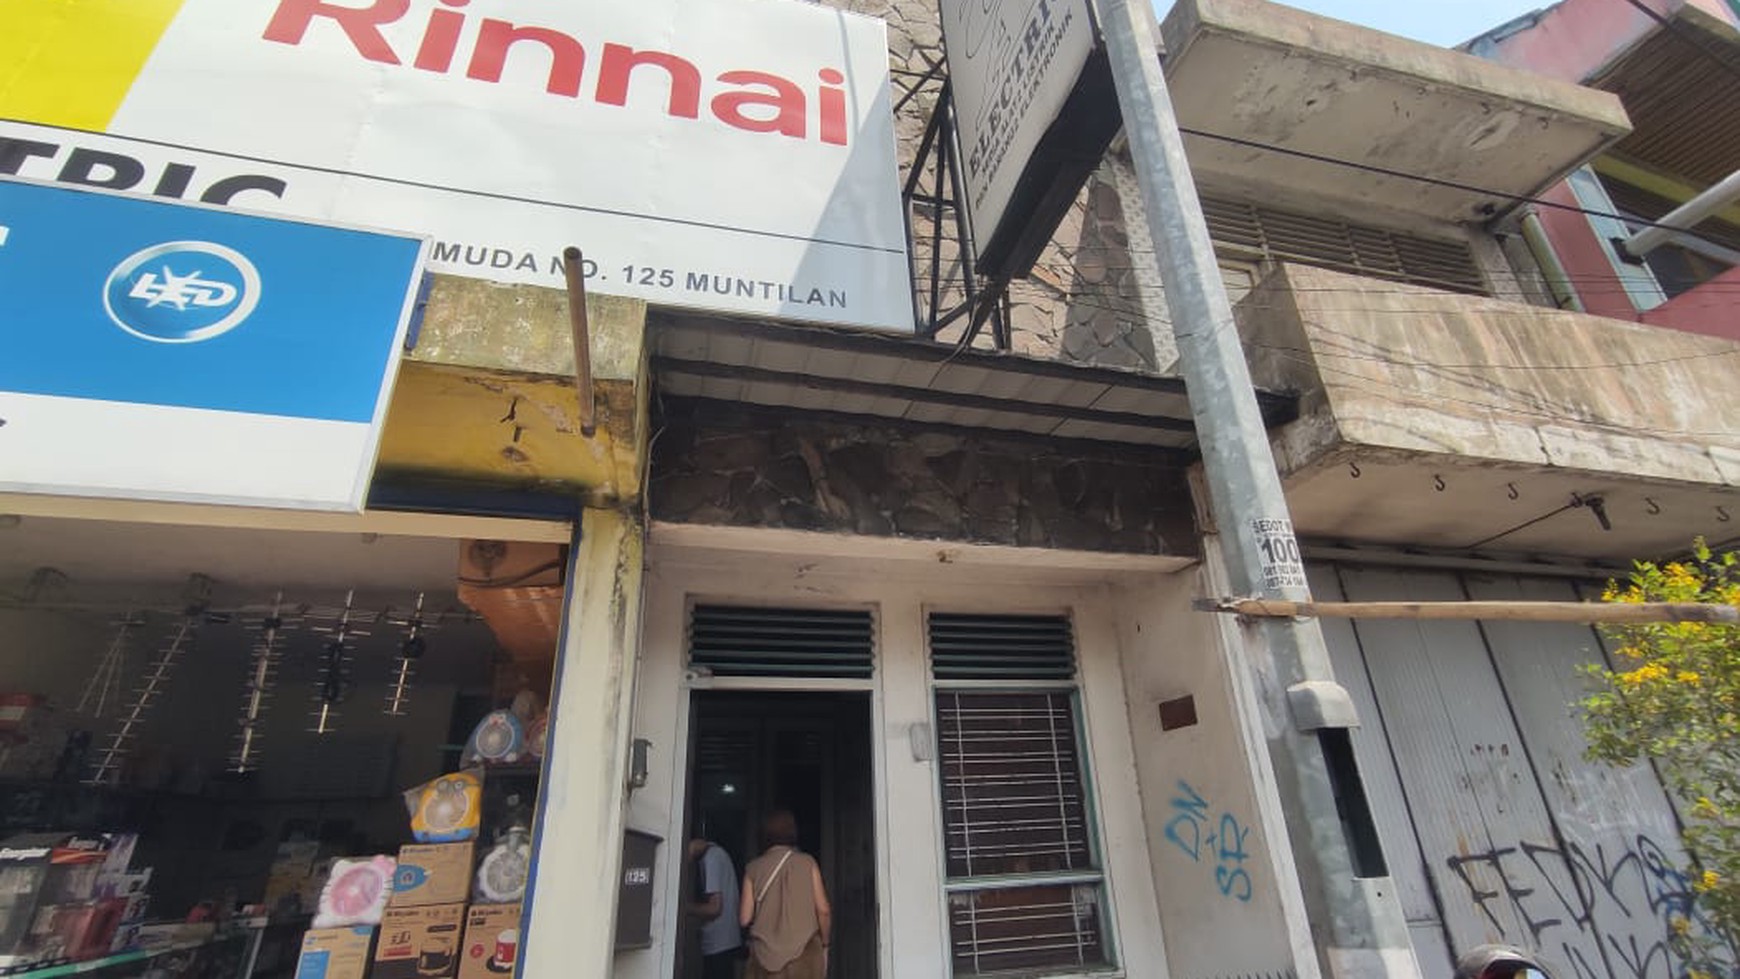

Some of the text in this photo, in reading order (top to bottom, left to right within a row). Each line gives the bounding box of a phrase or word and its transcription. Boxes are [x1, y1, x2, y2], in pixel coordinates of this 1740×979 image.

[262, 0, 848, 146] Rinnai
[969, 0, 1057, 179] ELECTRI
[1020, 4, 1073, 118] ELEKTRONIK
[433, 242, 537, 273] MUDA
[622, 265, 674, 288] 125
[686, 272, 847, 308] MUNTILAN
